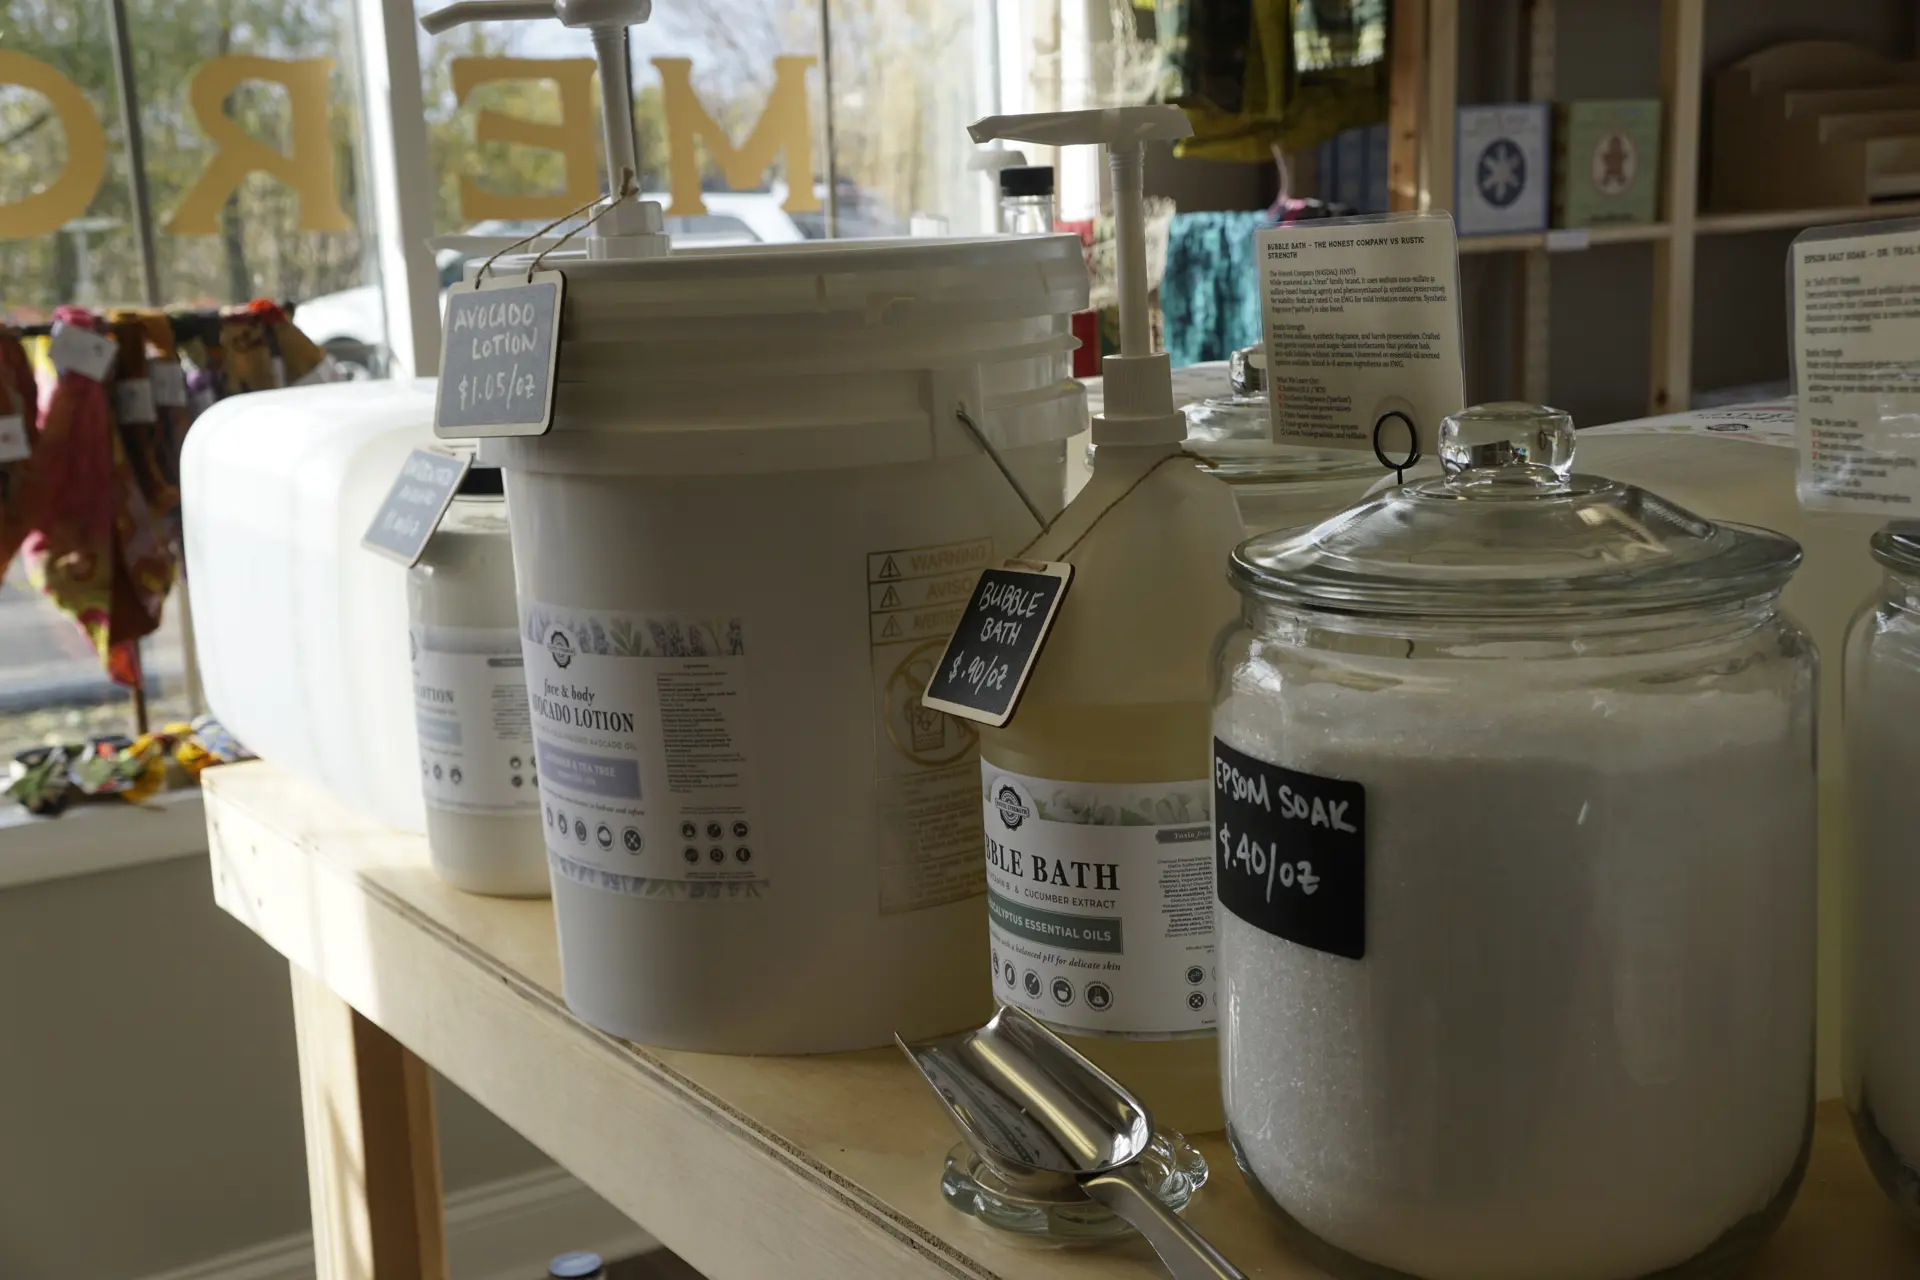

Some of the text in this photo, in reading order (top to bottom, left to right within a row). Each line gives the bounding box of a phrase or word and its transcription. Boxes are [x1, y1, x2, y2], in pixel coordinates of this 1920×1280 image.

[1268, 242, 1290, 250] BUBBLE
[1291, 242, 1306, 250] BATH
[1314, 240, 1326, 248] THE
[1328, 240, 1354, 248] HONEST
[1356, 238, 1388, 246] COMPANY
[1401, 236, 1424, 244] RUSTIC
[1268, 251, 1298, 260] STRENGTH
[454, 302, 535, 332] AVOCADO
[472, 327, 538, 360] LOTION
[458, 362, 536, 411] $1.05/oz
[980, 581, 1044, 618] BUBBLE
[980, 617, 1022, 646] BATH
[544, 678, 595, 706] face & body
[574, 707, 634, 732] LOTION
[590, 737, 622, 750] AVOCADO
[1216, 756, 1357, 834] EPSOM SOAK
[1031, 854, 1120, 890] BATH
[1014, 884, 1116, 909] & CUCUMBER EXTRACT
[1025, 918, 1080, 938] ESSENTIAL
[1083, 930, 1112, 942] OILS
[1016, 944, 1042, 960] balanced
[1042, 954, 1054, 964] pH
[1056, 955, 1067, 966] for
[1068, 958, 1100, 970] delicate
[1103, 961, 1121, 972] skin
